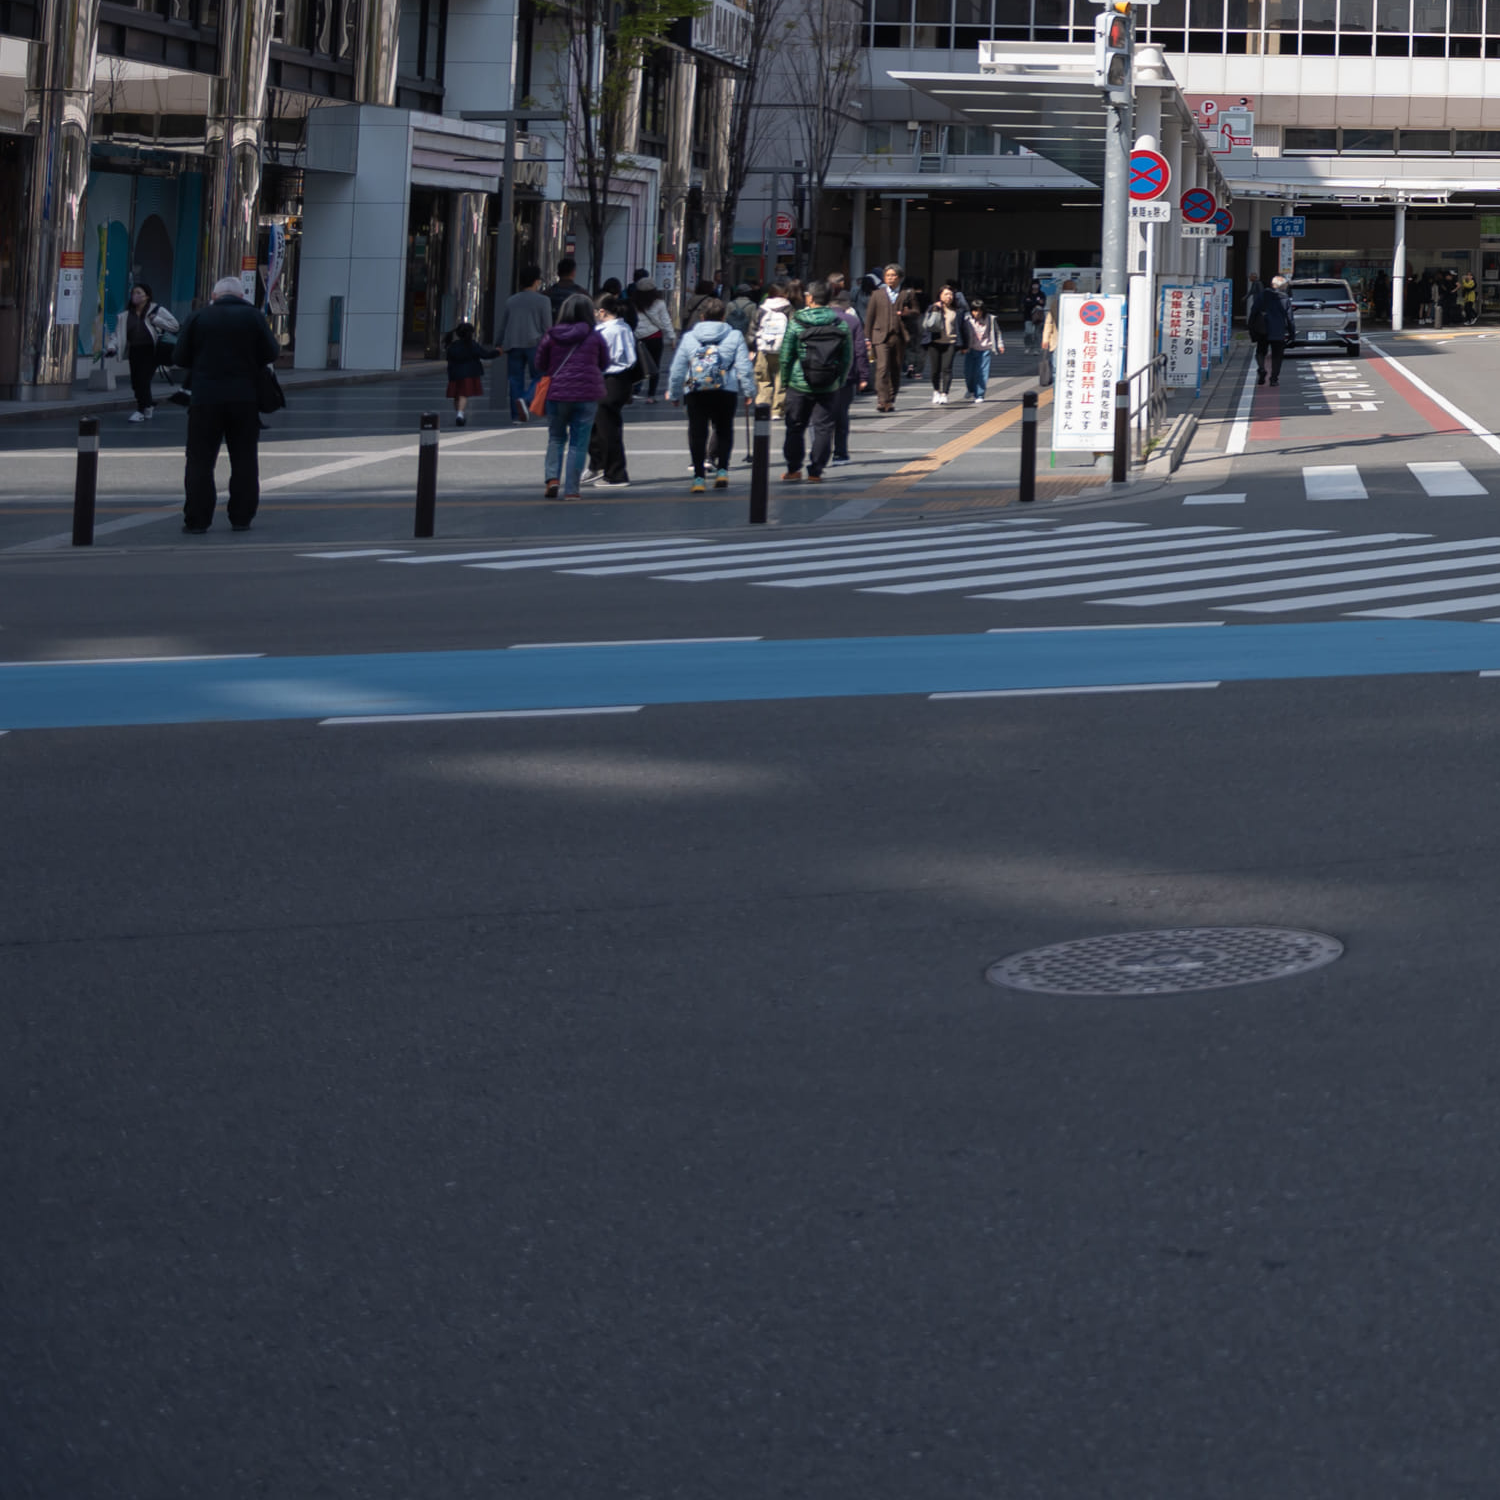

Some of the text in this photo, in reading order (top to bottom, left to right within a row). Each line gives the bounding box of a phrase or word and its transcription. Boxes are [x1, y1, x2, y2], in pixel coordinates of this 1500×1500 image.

[1129, 206, 1167, 218] 乗降を除く
[1184, 291, 1196, 355] 人を待つための
[1080, 330, 1099, 430] 駐停車禁止です
